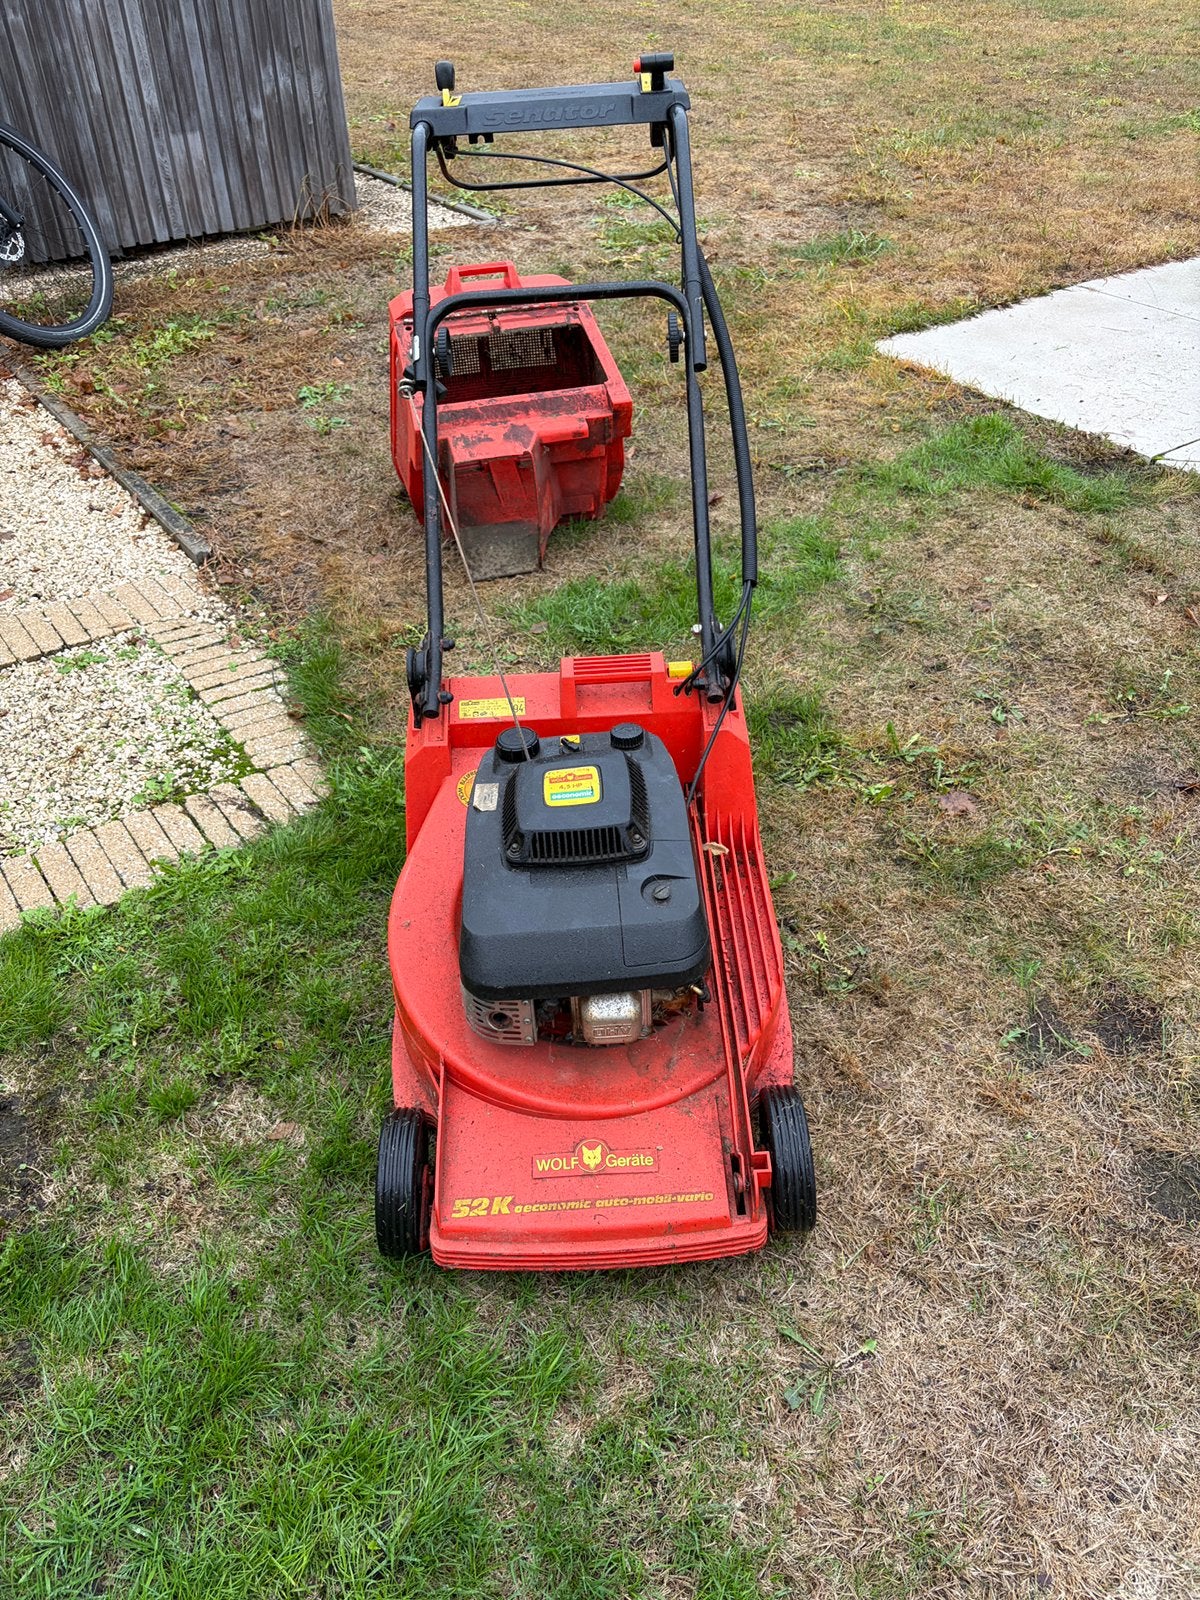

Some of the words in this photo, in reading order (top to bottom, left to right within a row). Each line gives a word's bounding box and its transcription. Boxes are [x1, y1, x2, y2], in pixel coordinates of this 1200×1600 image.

[482, 103, 616, 127] Senator
[536, 1157, 579, 1172] WOLF
[605, 1153, 654, 1167] Geräte
